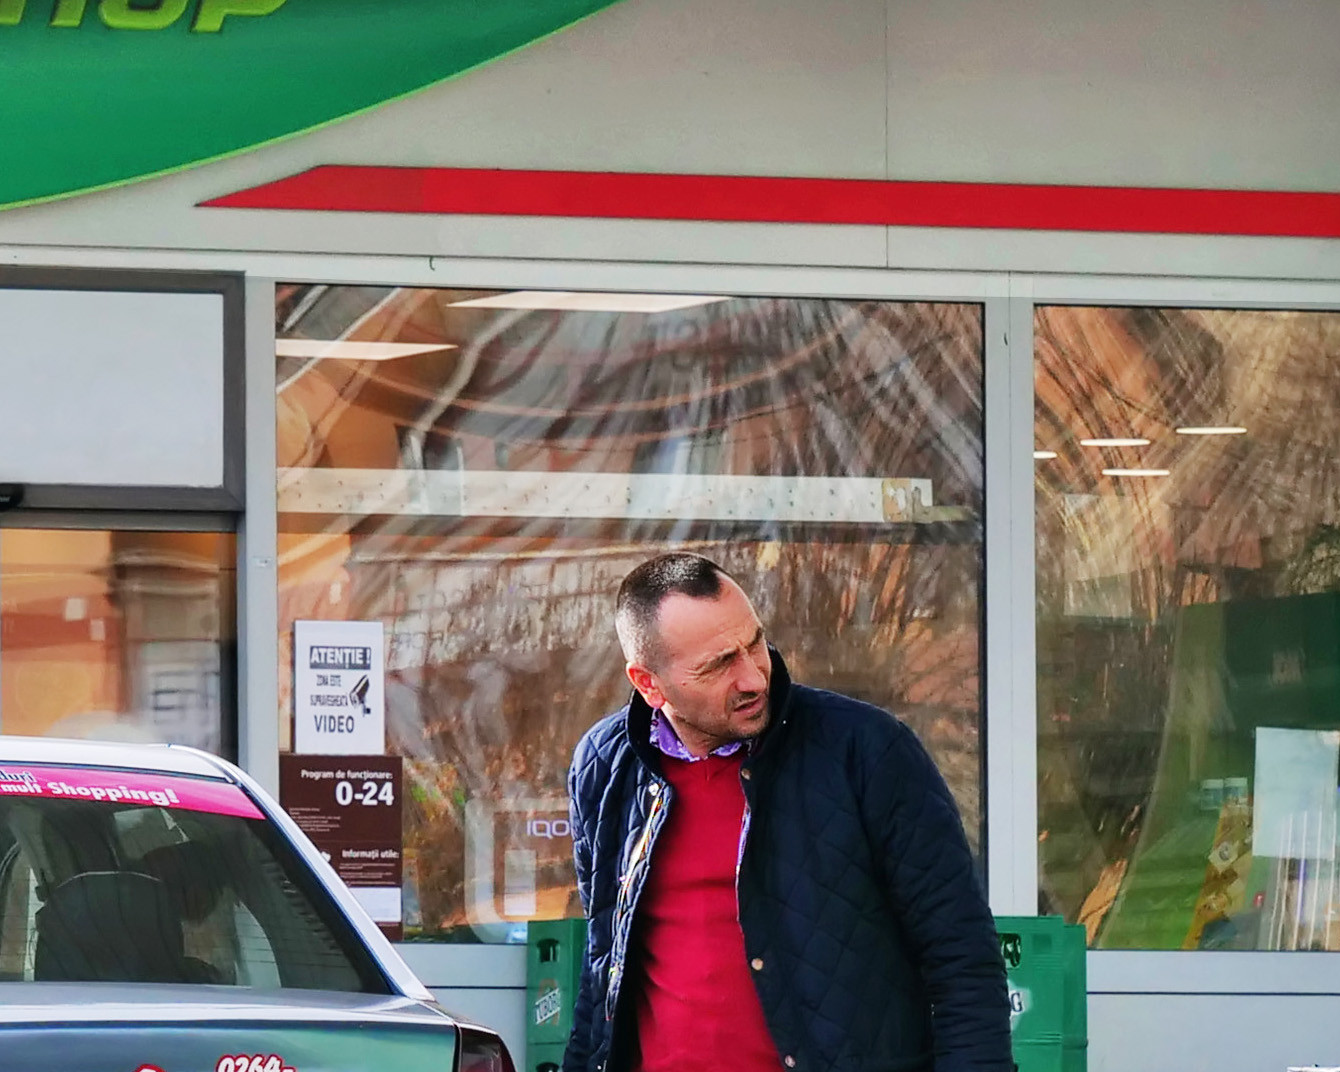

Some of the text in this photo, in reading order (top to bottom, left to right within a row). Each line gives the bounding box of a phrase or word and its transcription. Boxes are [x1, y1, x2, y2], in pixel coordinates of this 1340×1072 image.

[314, 715, 355, 733] VIDEO
[301, 769, 334, 780] Program
[335, 769, 345, 779] de
[49, 781, 180, 806] Shopping!
[335, 781, 394, 806] 0-24
